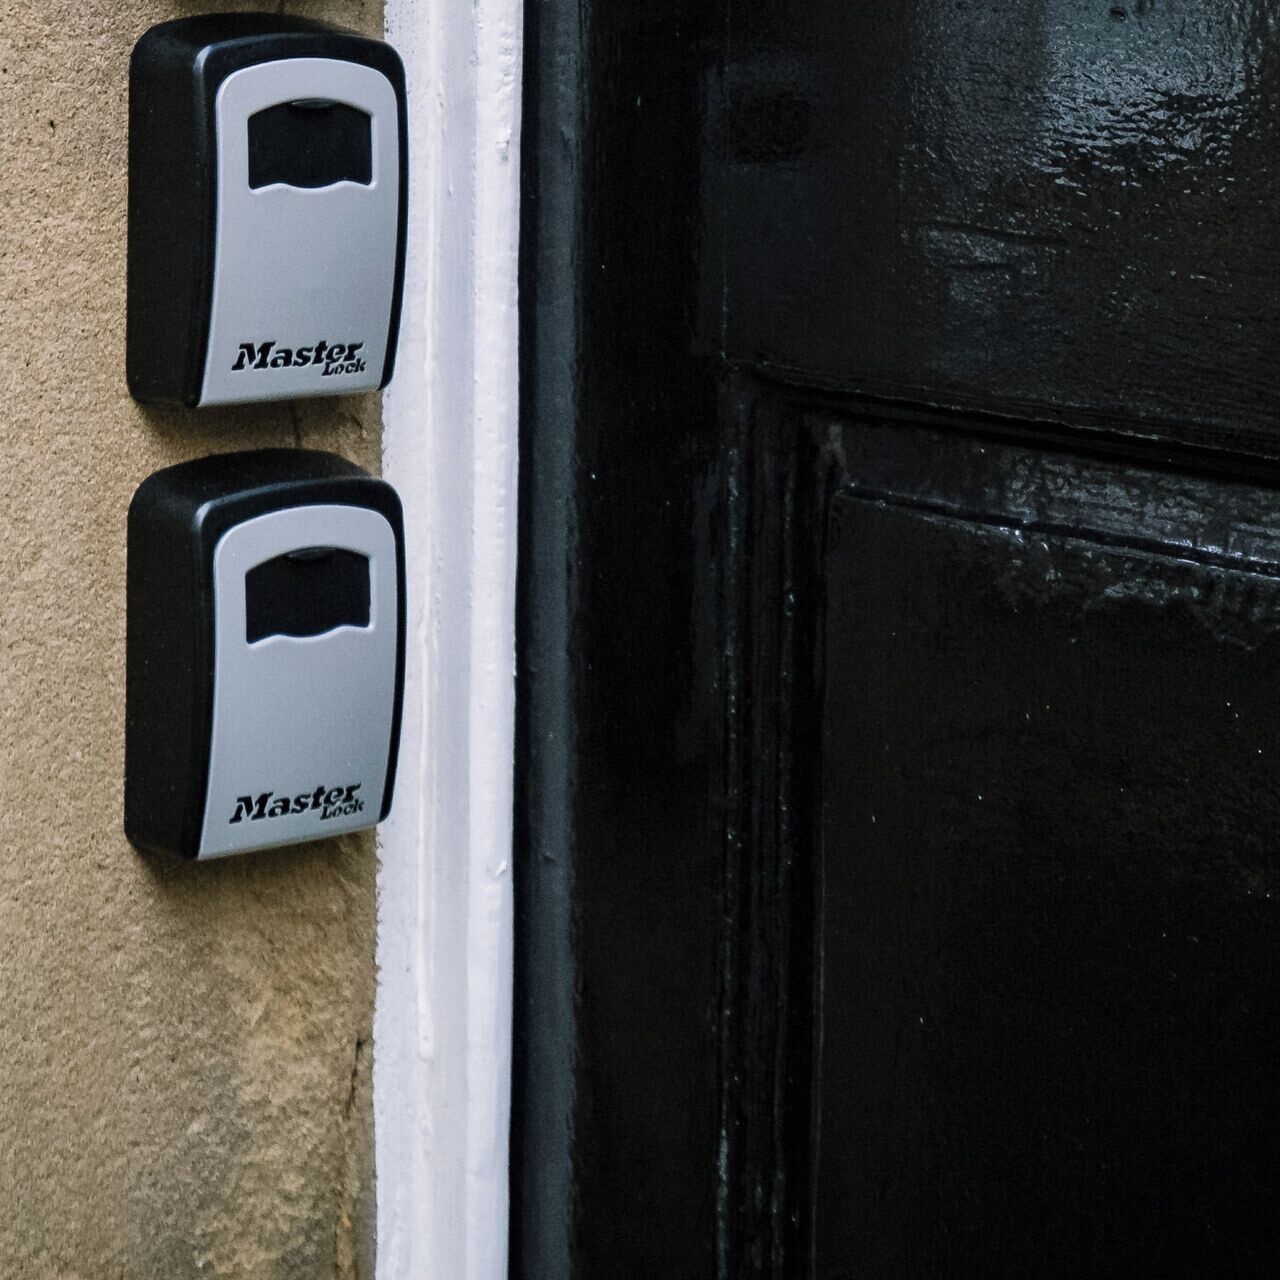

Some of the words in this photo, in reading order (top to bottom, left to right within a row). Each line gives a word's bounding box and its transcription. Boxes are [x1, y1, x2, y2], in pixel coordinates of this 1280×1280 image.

[231, 340, 365, 371] Master
[321, 358, 367, 377] Lock
[228, 782, 362, 825] Master
[320, 798, 365, 821] Lock
